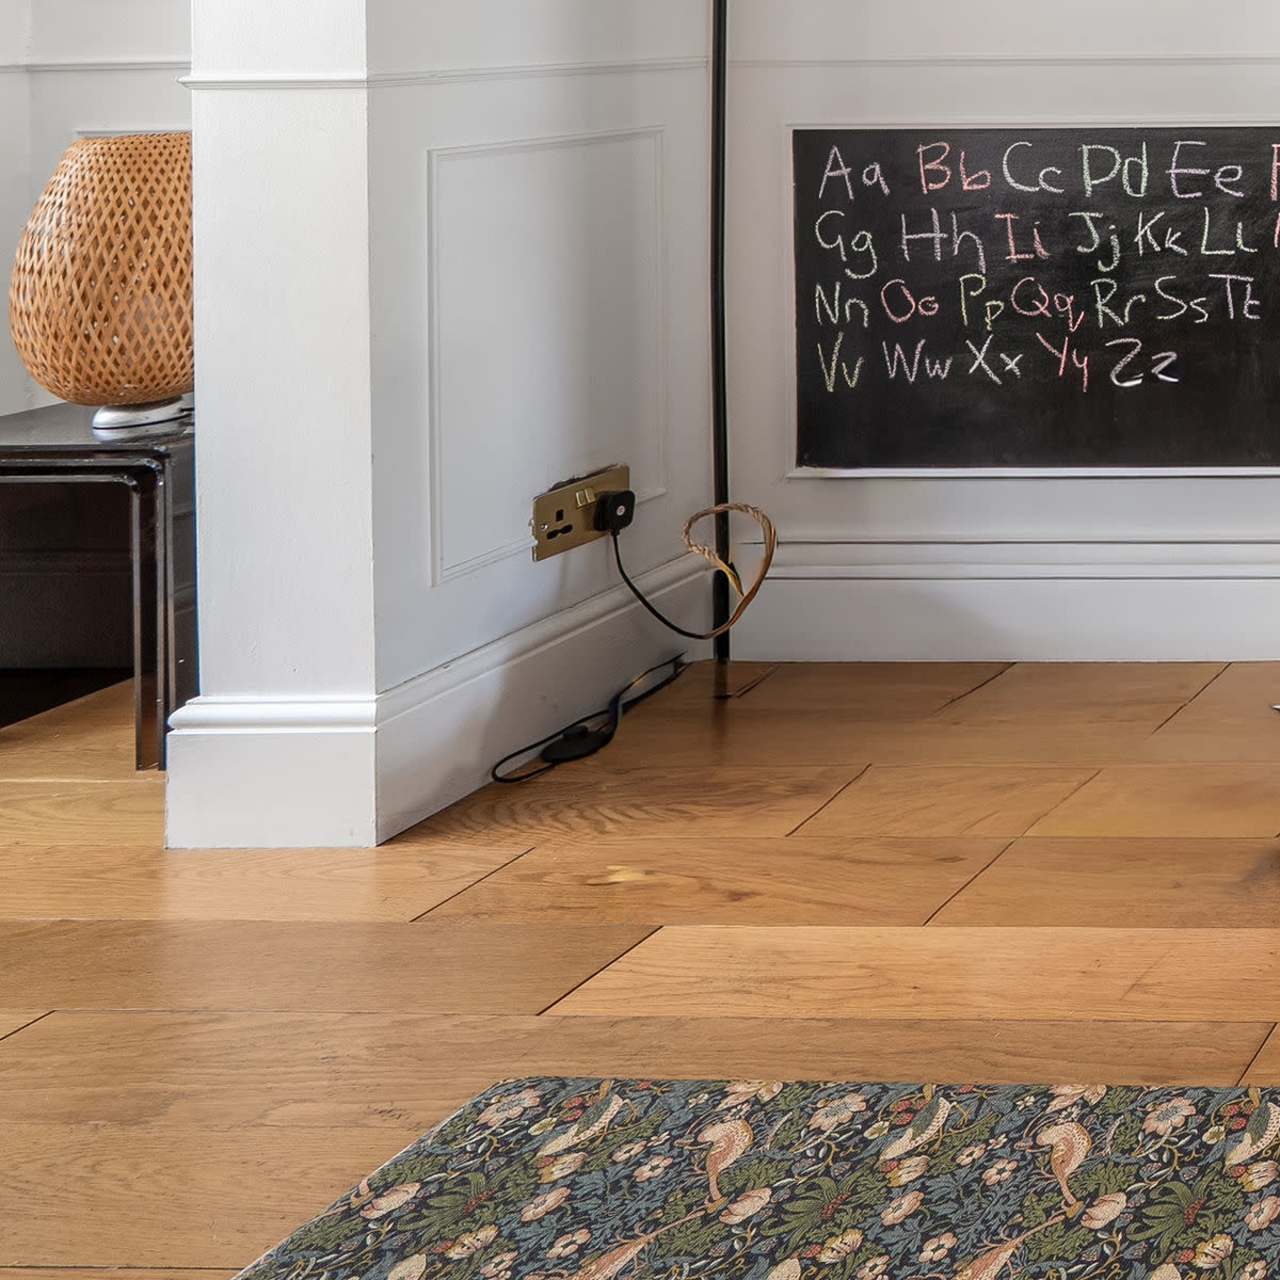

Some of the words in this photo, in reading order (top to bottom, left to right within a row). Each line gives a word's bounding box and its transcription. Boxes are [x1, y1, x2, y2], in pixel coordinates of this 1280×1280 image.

[818, 145, 890, 200] Aa
[915, 141, 992, 194] Bb
[1002, 141, 1065, 194] Cc
[1077, 141, 1149, 198] Dd
[1166, 140, 1245, 199] Ee
[815, 210, 877, 280] Gg
[900, 208, 986, 275] Hh
[994, 212, 1053, 262] Ii
[1068, 211, 1122, 273] Jj
[1135, 211, 1188, 258] Kk
[1200, 207, 1258, 256] Ll
[815, 282, 870, 328] Nn
[880, 279, 940, 325] Oo
[959, 273, 1006, 331] Pp
[1010, 276, 1086, 333] Qq
[1091, 277, 1147, 329] Rr
[1154, 275, 1209, 325] Ss
[1208, 273, 1262, 321] Tt
[817, 331, 865, 393] Vv
[881, 338, 954, 384] Ww
[965, 333, 1024, 386] Xx
[1035, 331, 1090, 393] Yy
[1105, 336, 1181, 388] Zz
